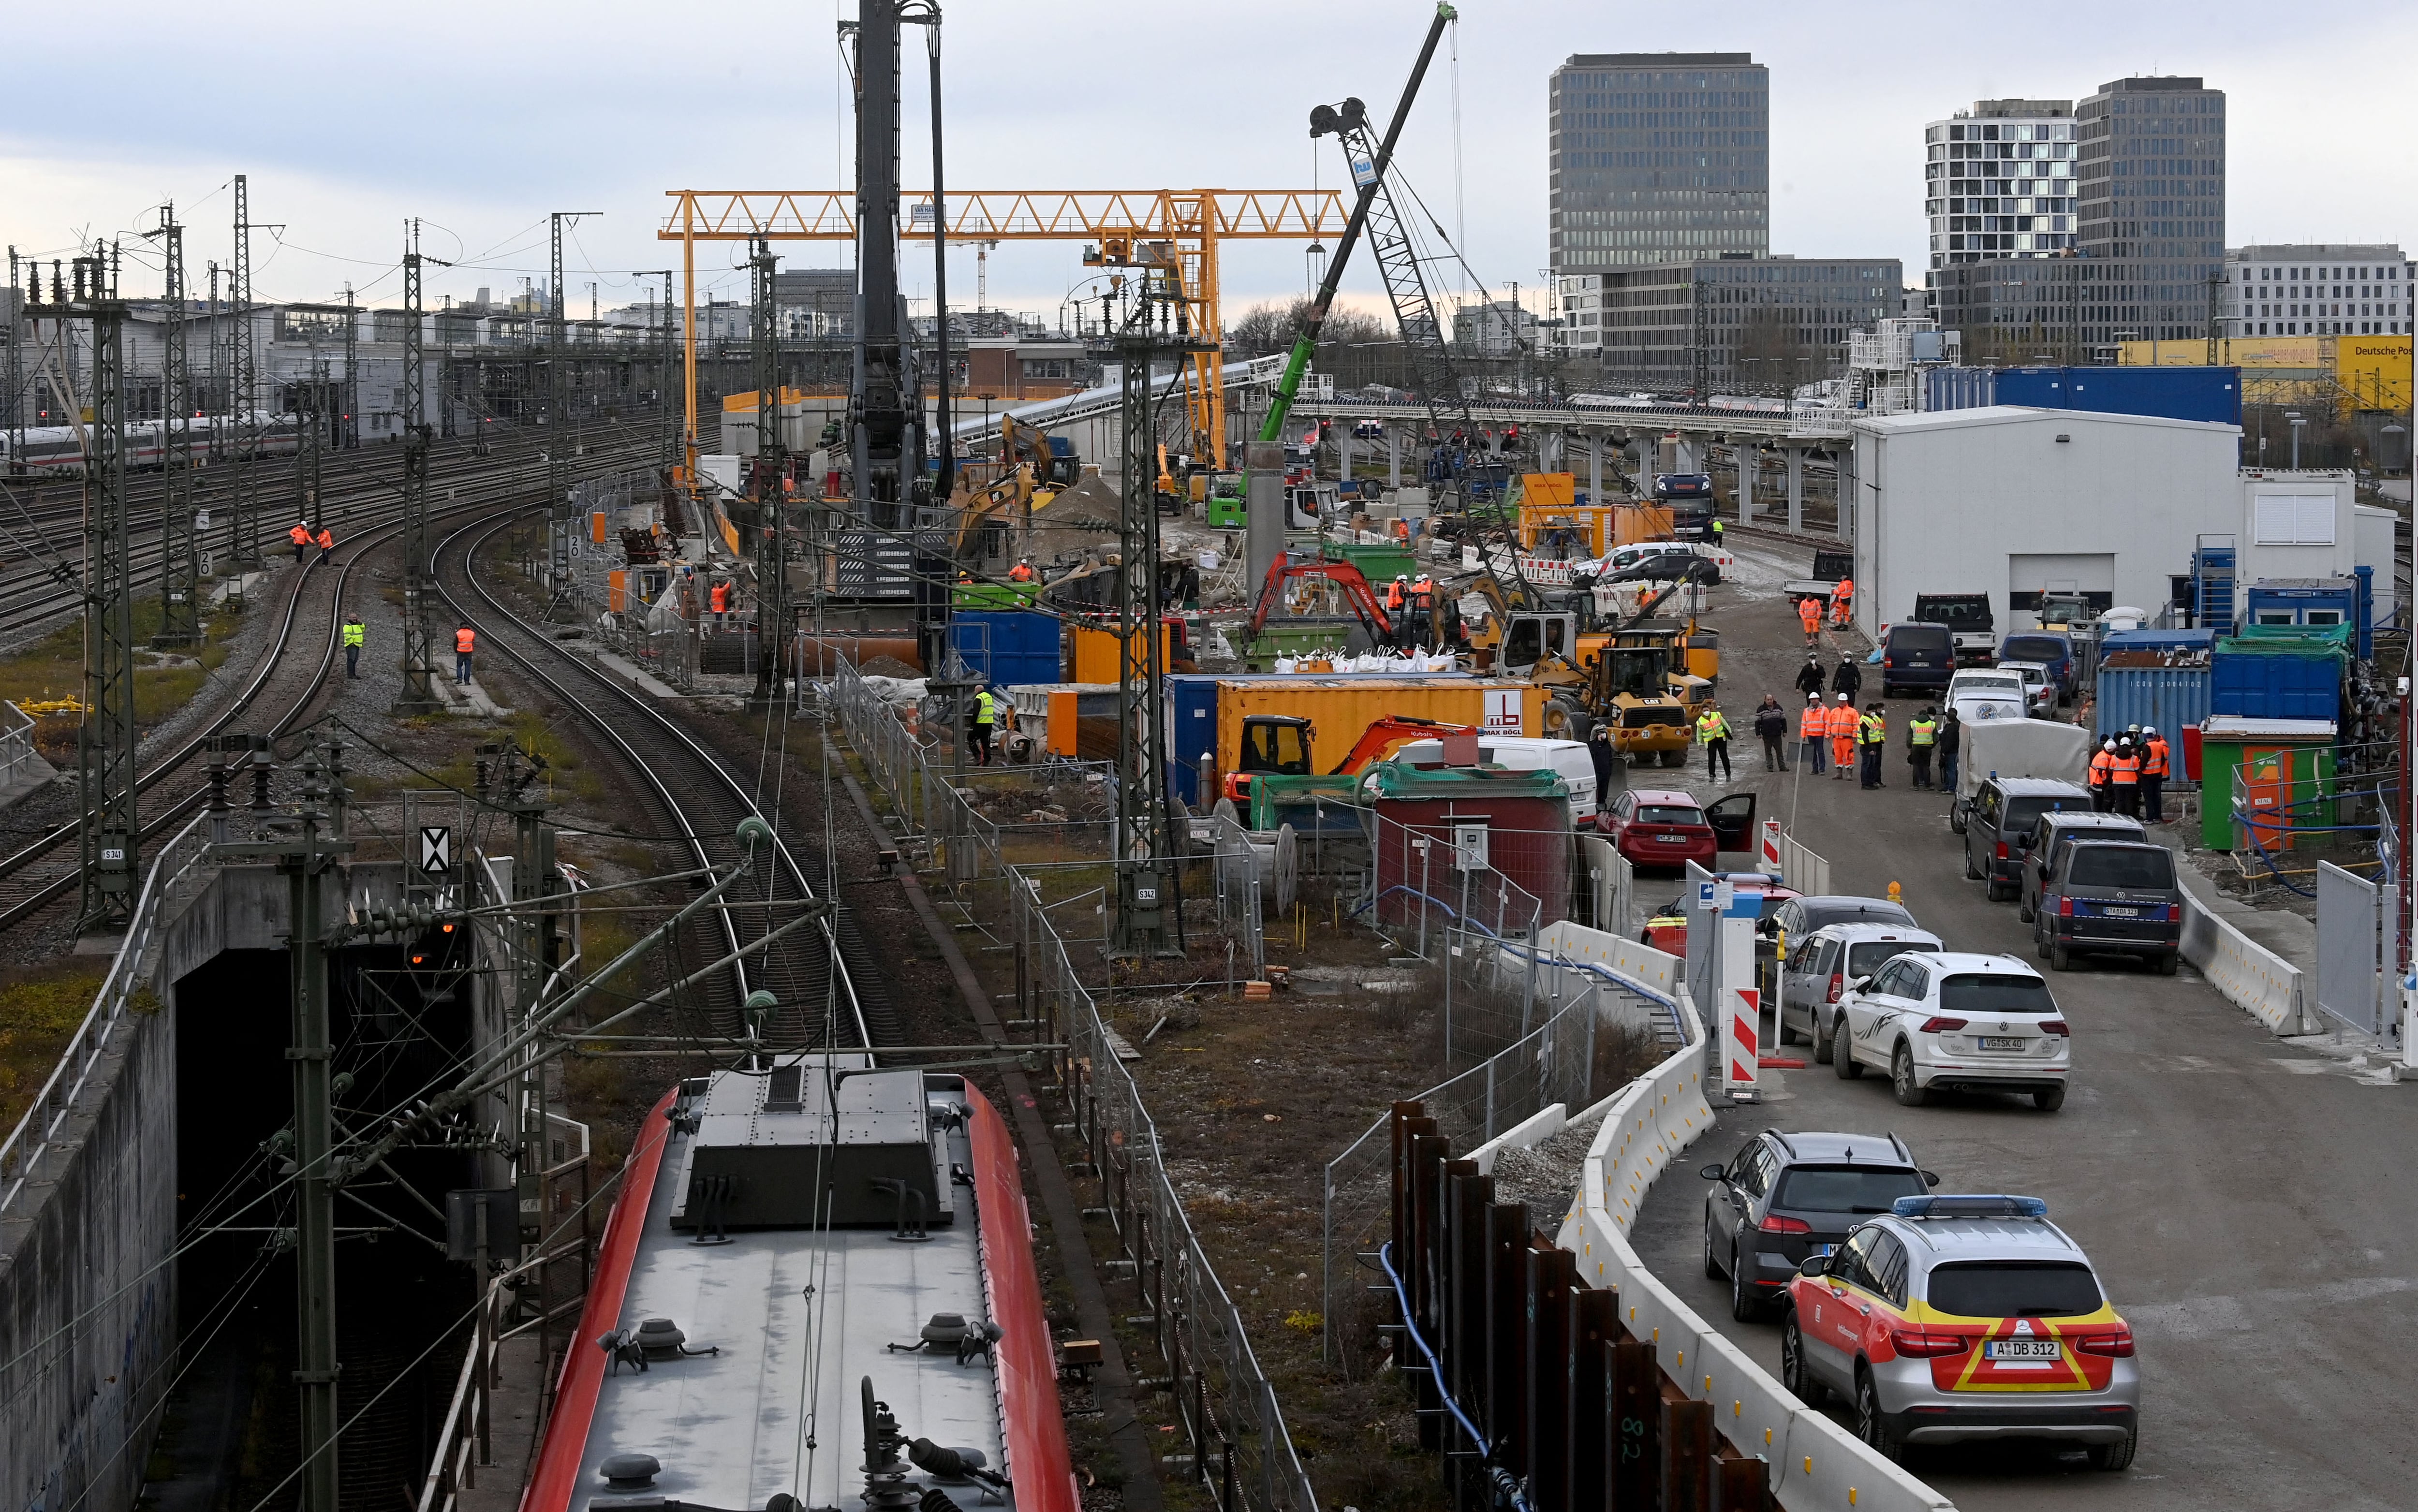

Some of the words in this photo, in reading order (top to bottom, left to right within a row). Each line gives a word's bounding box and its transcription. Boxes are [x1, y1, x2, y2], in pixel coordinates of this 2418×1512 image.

[2356, 347, 2396, 355] Deutsche
[2398, 347, 2412, 355] Pos
[1997, 1343, 2005, 1355] A
[2013, 1343, 2029, 1355] DB
[2032, 1343, 2055, 1355] 312
